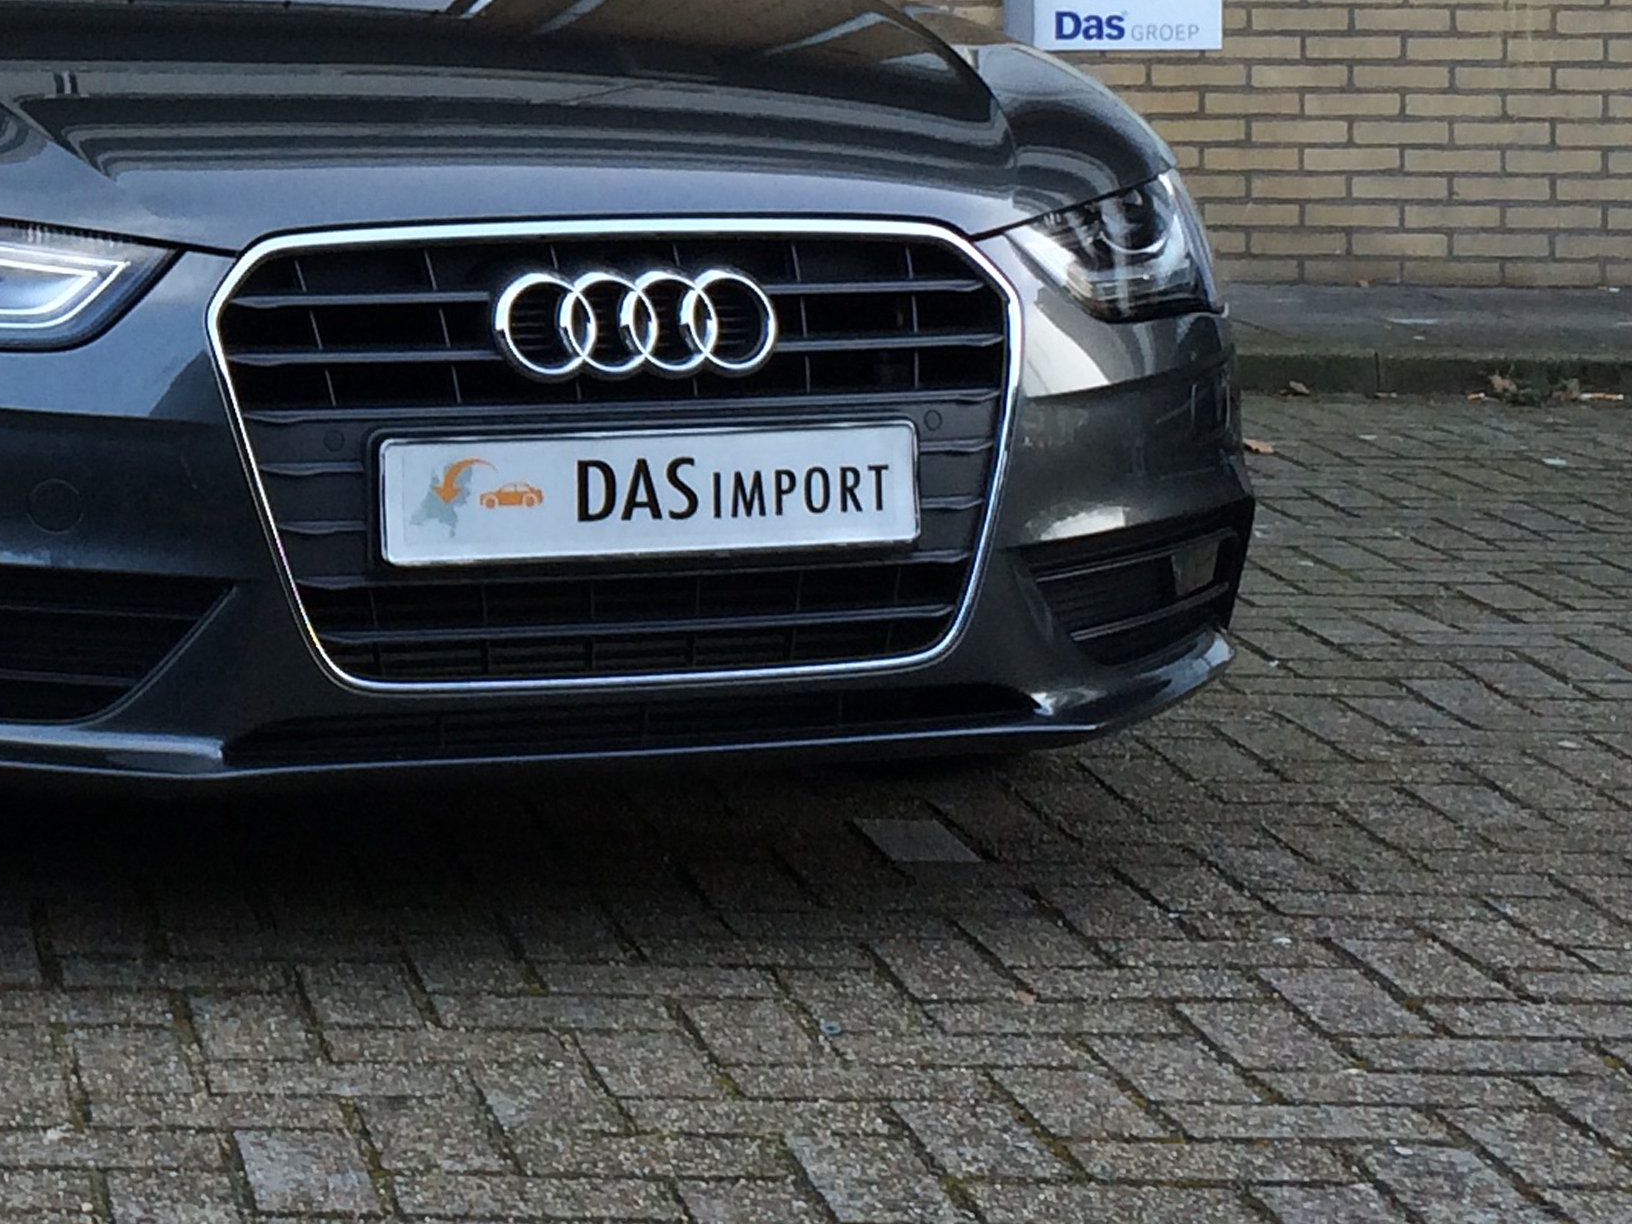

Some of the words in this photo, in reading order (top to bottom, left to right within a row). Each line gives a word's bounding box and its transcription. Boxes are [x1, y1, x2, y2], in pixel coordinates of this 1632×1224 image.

[1054, 10, 1126, 41] Das
[1130, 24, 1200, 42] GROEP
[576, 456, 699, 523] DAS
[712, 463, 890, 519] IMPORT
